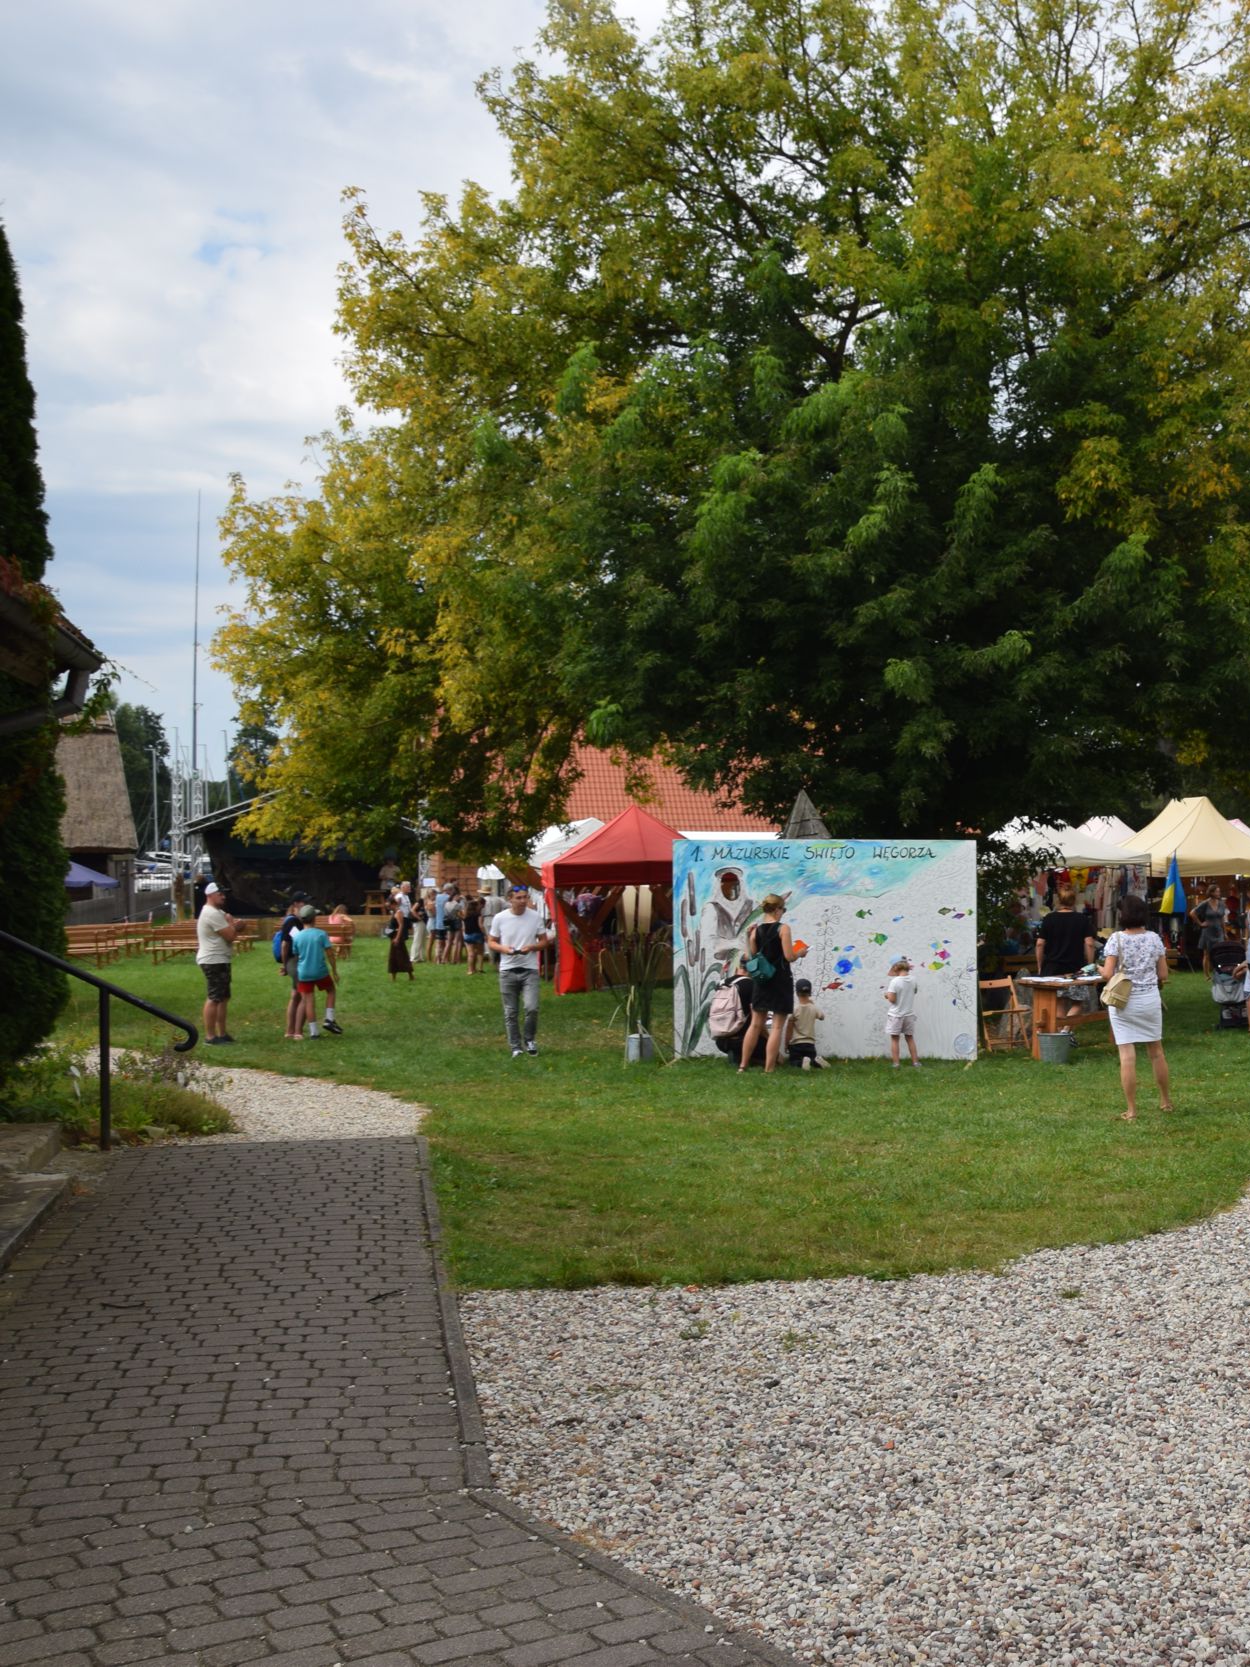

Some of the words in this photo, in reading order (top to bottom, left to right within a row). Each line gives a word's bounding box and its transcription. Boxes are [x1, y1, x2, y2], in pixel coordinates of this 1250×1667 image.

[690, 845, 704, 862] 1.
[711, 846, 790, 860] MAZURSKIE
[873, 846, 936, 861] WĘGORZA
